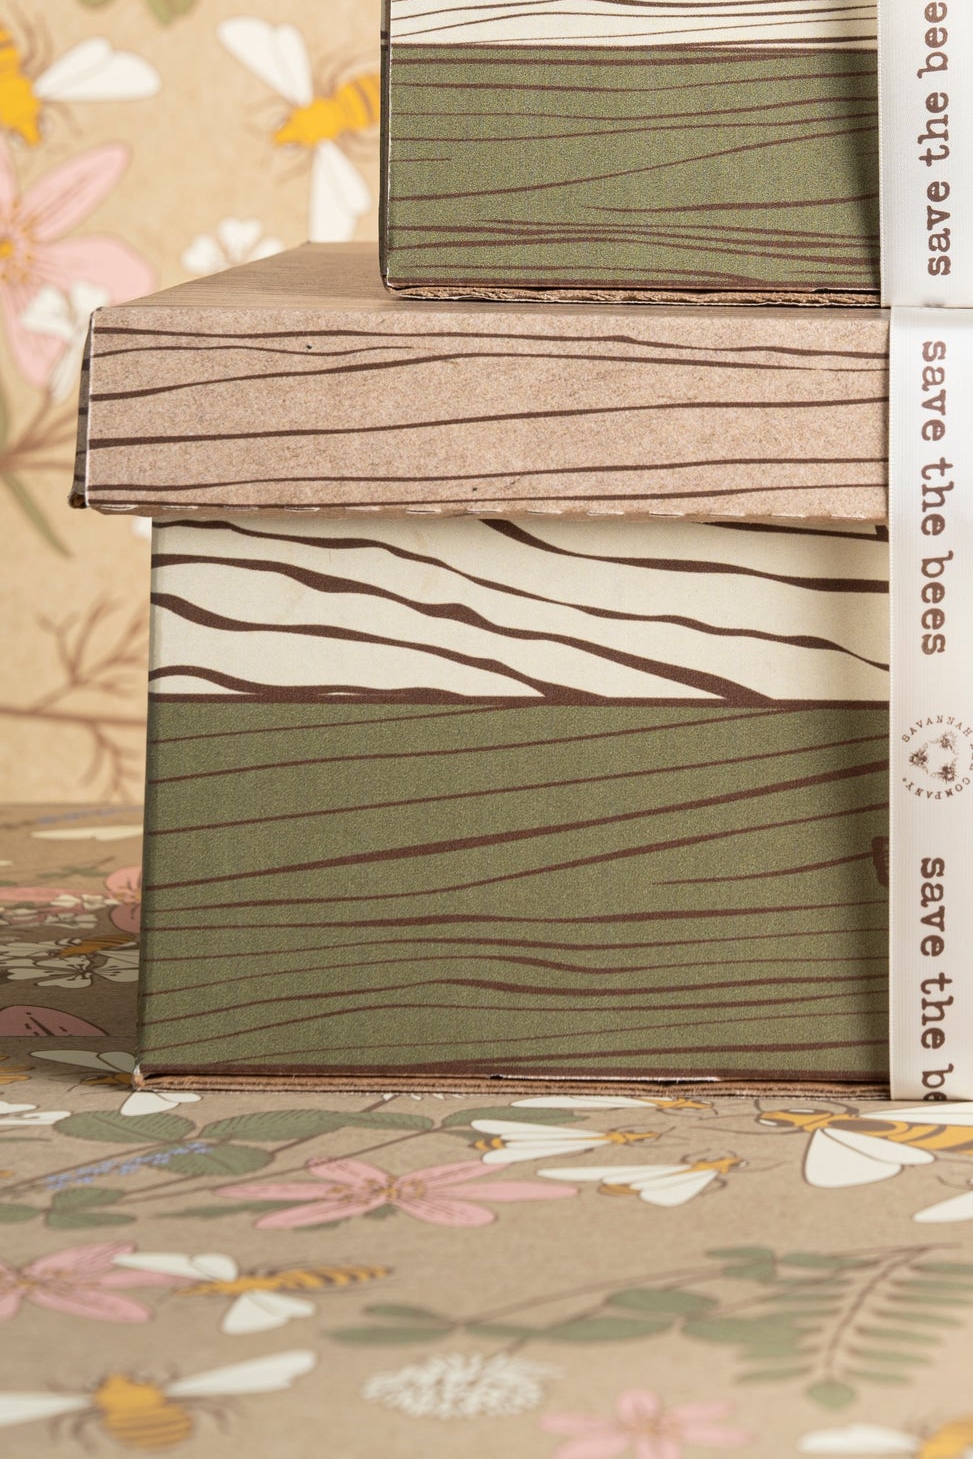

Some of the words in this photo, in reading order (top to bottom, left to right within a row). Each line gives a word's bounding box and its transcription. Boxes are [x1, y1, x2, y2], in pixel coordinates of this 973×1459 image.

[917, 92, 950, 167] the
[927, 181, 951, 276] save
[922, 342, 946, 441] save
[921, 457, 954, 536] the
[921, 550, 953, 655] bees
[901, 714, 973, 743] SAVANNAH
[920, 858, 945, 957] save
[920, 972, 954, 1049] the
